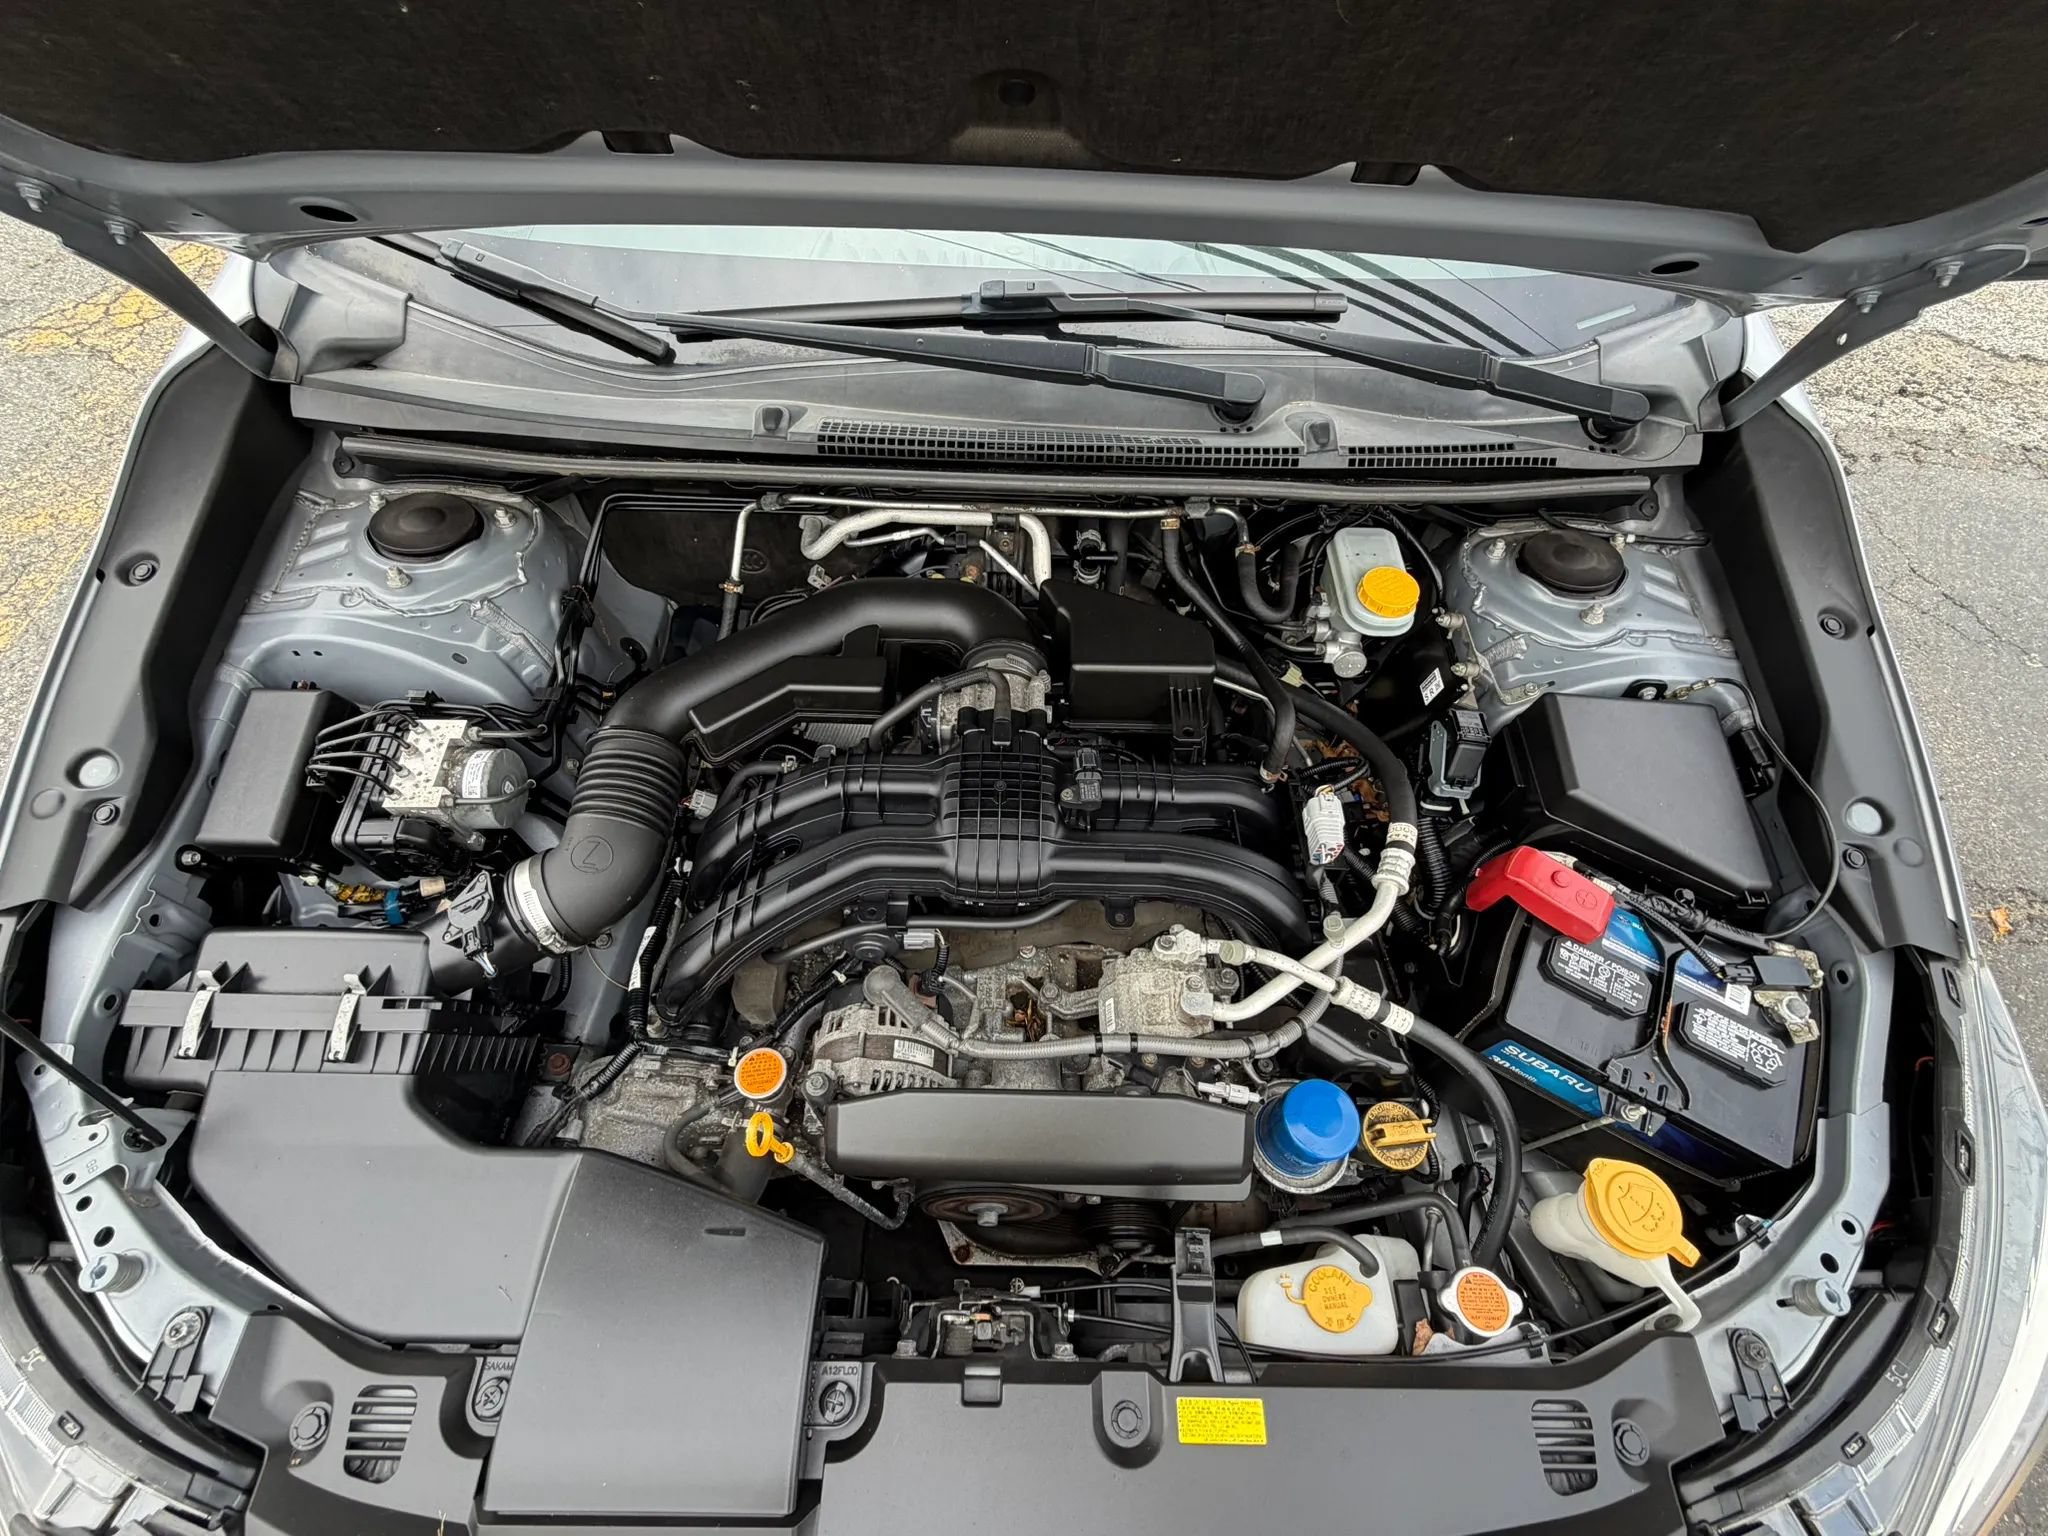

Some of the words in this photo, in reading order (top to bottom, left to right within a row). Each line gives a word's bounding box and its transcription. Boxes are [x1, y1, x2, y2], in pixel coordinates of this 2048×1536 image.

[1572, 943, 1605, 966] DANGER
[1611, 962, 1641, 981] POISON
[1503, 1045, 1595, 1093] SUBARU
[1509, 1066, 1538, 1083] Month
[1368, 1103, 1396, 1120] ENGINE
[1397, 1105, 1410, 1116] OIL
[1308, 1268, 1353, 1293] COOLANT
[1324, 1301, 1350, 1311] MANUAL
[20, 1347, 46, 1372] 5C
[821, 1365, 859, 1376] A12FL00
[1884, 1364, 1909, 1388] 5C
